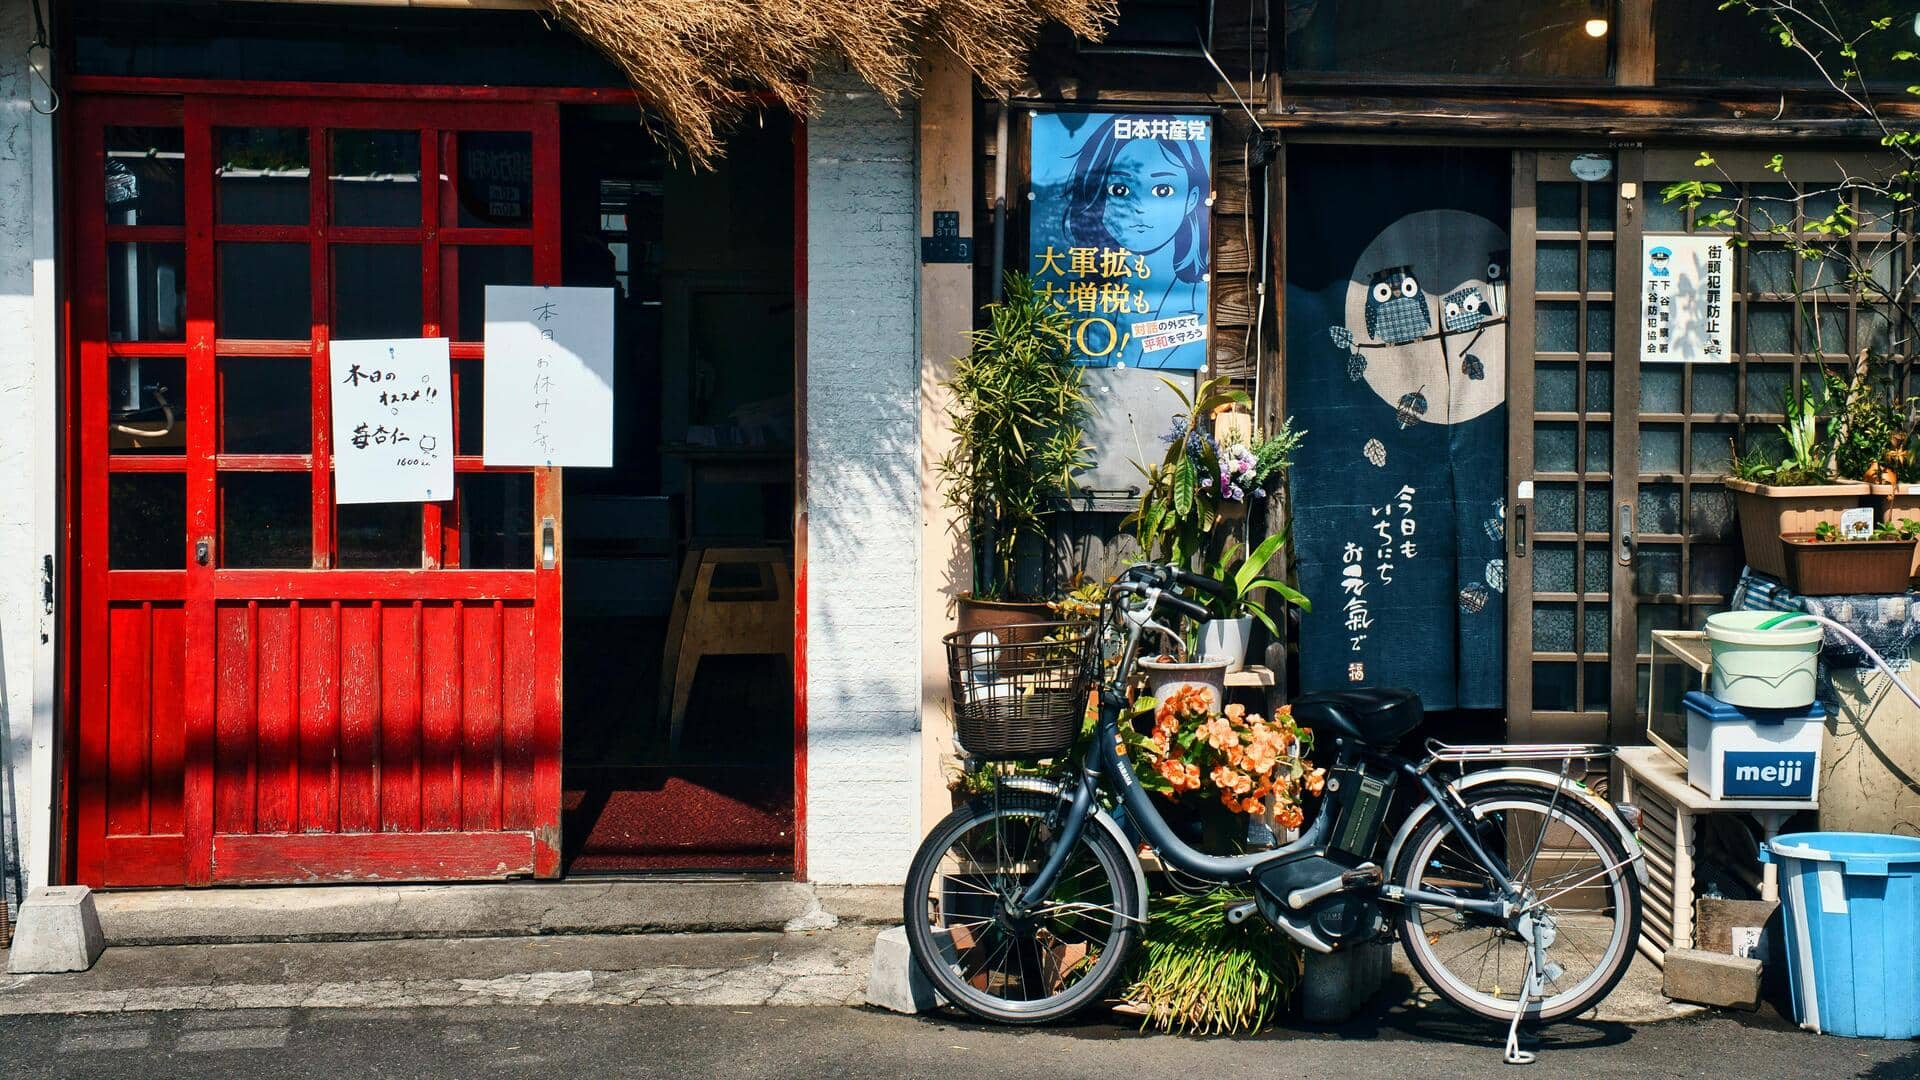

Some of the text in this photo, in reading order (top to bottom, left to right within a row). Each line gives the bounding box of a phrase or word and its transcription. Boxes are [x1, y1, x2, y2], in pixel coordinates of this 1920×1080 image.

[1115, 119, 1206, 140] 日本共産党
[1035, 246, 1150, 279] 大軍拡も
[1034, 281, 1149, 314] 大増税も
[1706, 245, 1722, 333] 街頭犯罪防止
[1134, 318, 1196, 335] 対話の外交で
[1144, 329, 1203, 350] 平和を守ろう
[343, 364, 396, 387] 本日の
[532, 303, 558, 453] 本日お休みです。
[1394, 484, 1418, 559] 今日も
[1371, 504, 1394, 586] いちにち
[1117, 761, 1133, 786] YAMAHA
[1735, 760, 1802, 787] meiji
